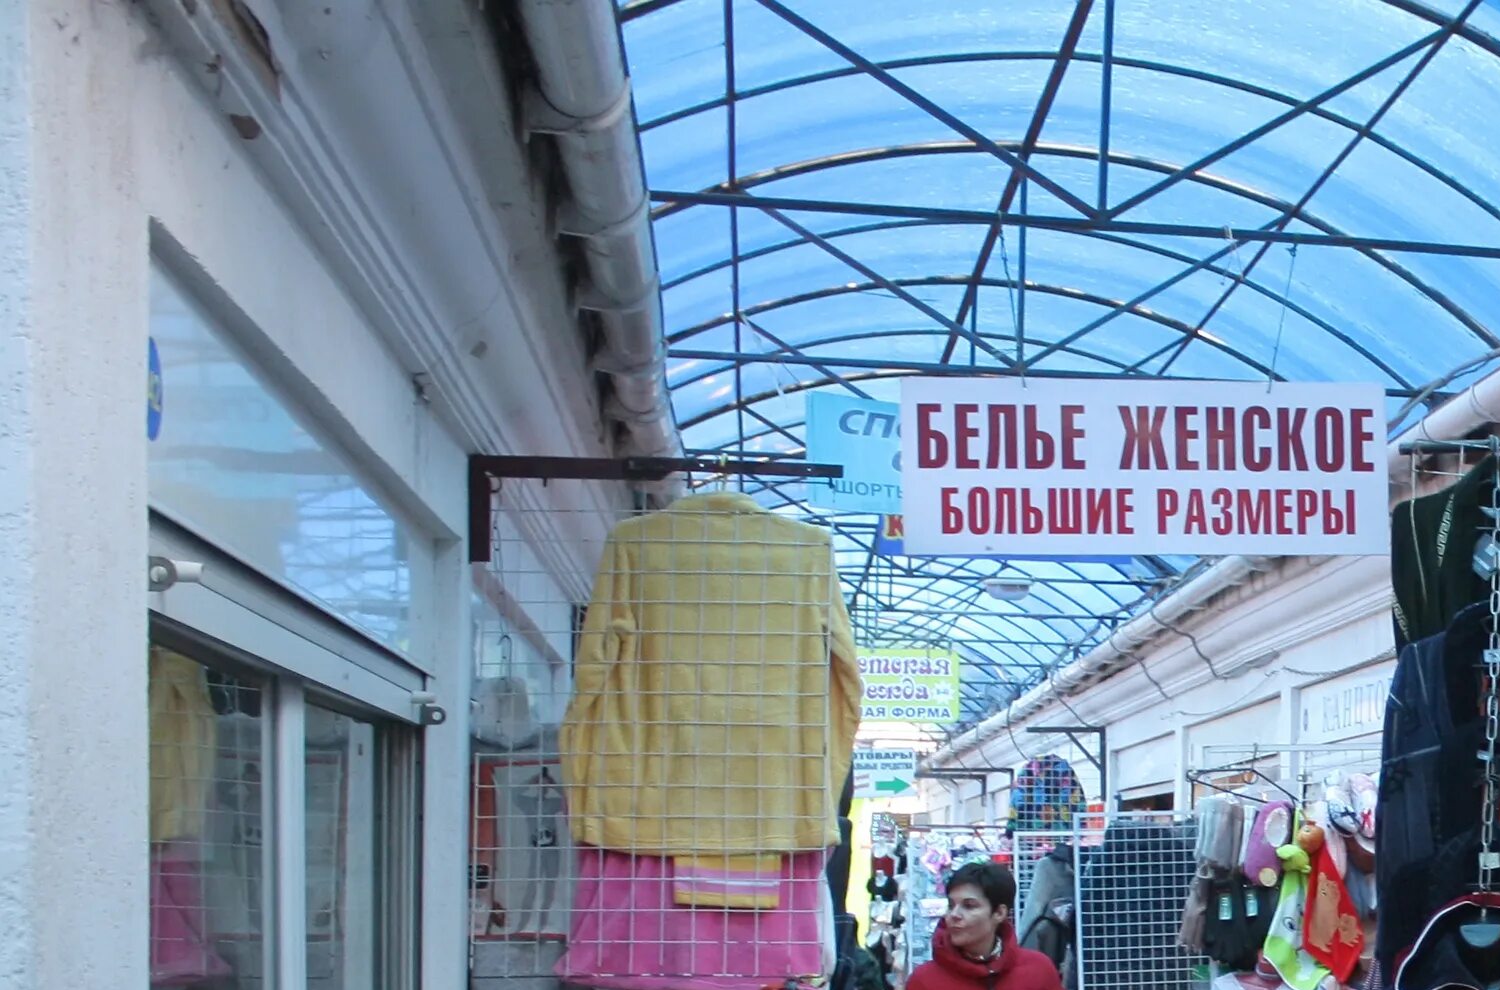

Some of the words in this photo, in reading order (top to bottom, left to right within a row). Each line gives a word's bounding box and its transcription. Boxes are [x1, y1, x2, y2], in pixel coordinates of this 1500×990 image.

[839, 409, 902, 438] СП
[917, 403, 1086, 470] БЕЛЬЕ
[1119, 405, 1375, 473] ЖЕНСКОЕ
[941, 486, 1134, 535] БОЛЬШИЕ
[1157, 488, 1356, 536] РАЗМЕРЫ
[857, 657, 950, 675] етская
[859, 678, 929, 700] ежда
[892, 707, 951, 718] ФОРМА
[1321, 678, 1392, 733] КАНЦТО
